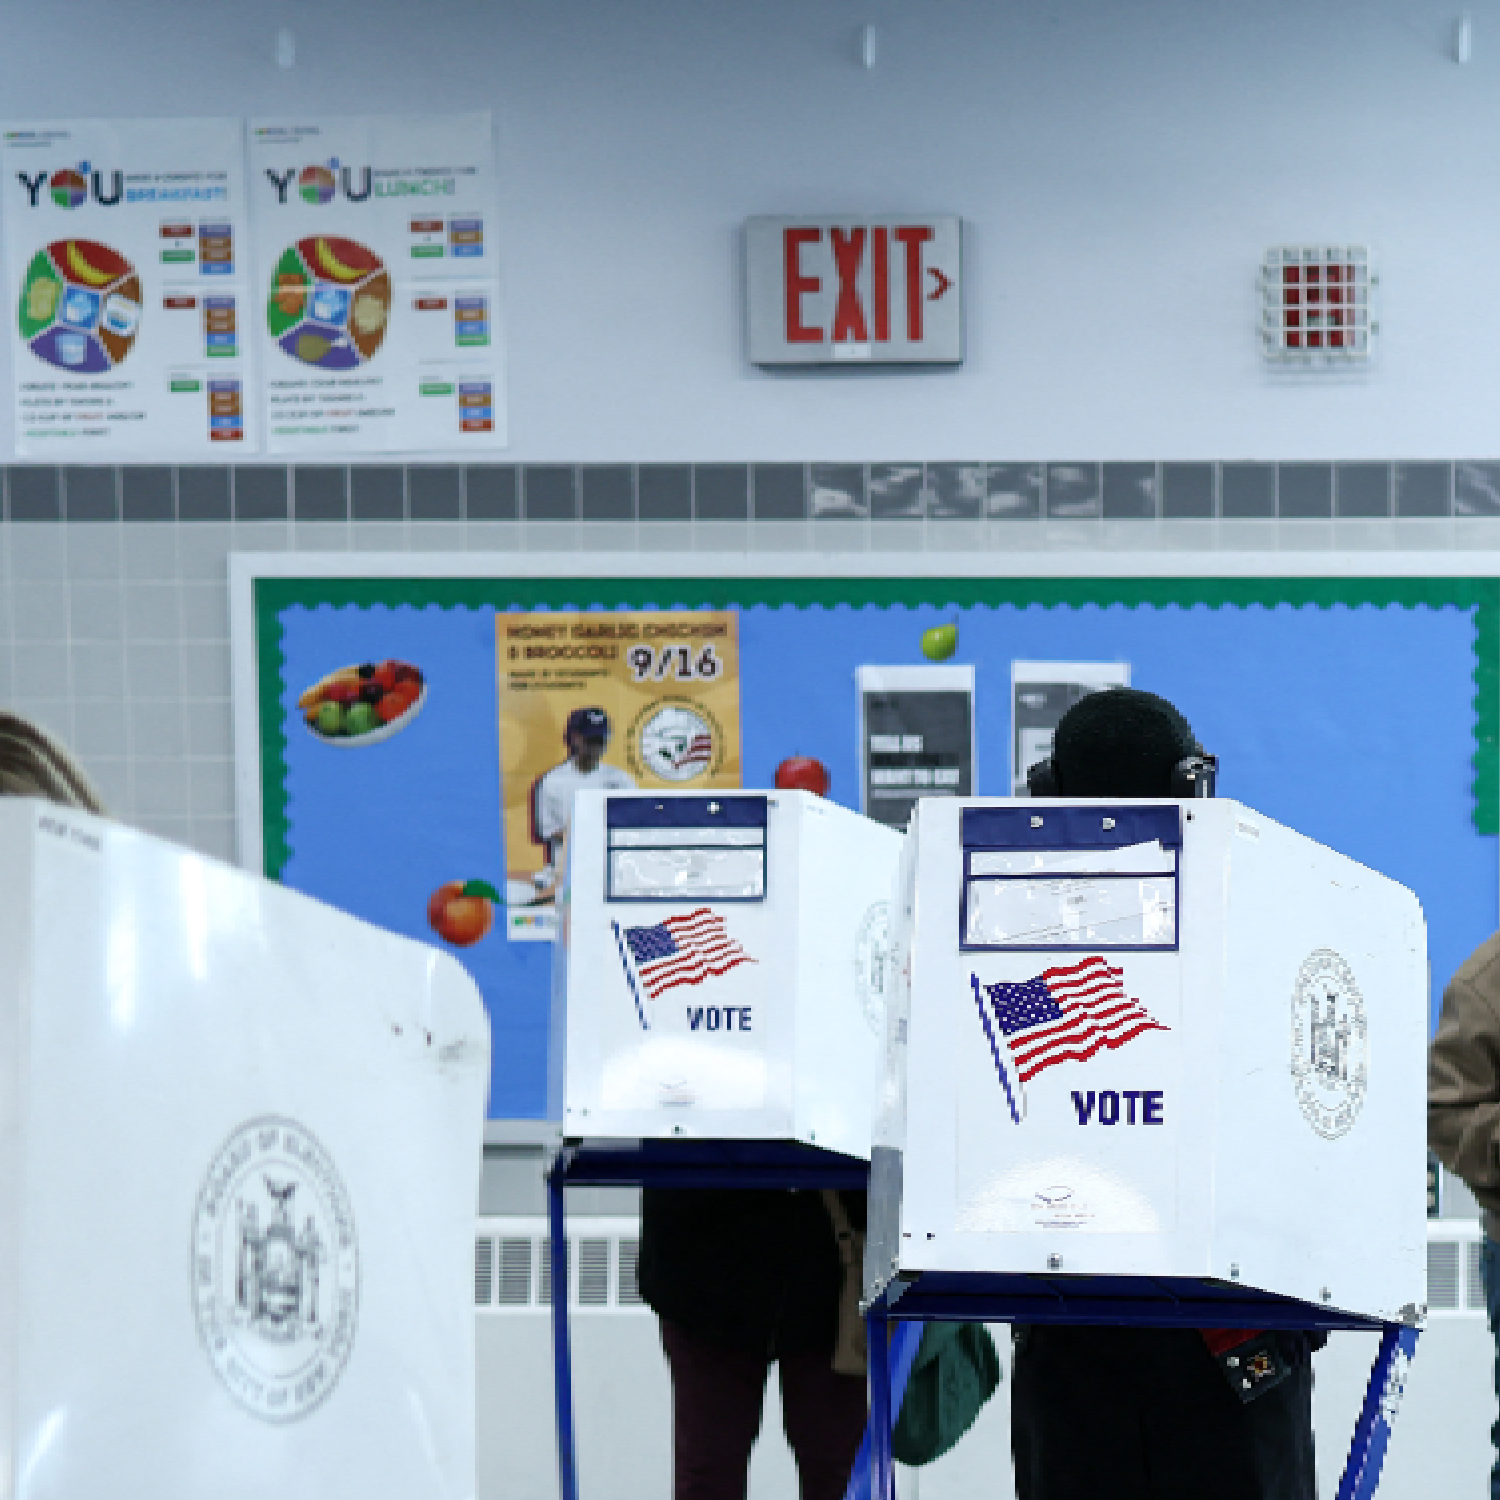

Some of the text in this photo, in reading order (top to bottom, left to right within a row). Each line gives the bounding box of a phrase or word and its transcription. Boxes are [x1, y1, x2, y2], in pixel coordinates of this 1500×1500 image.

[783, 225, 935, 343] EXIT
[629, 645, 720, 680] 9/16
[686, 1005, 752, 1031] VOTE
[1071, 1090, 1165, 1126] VOTE
